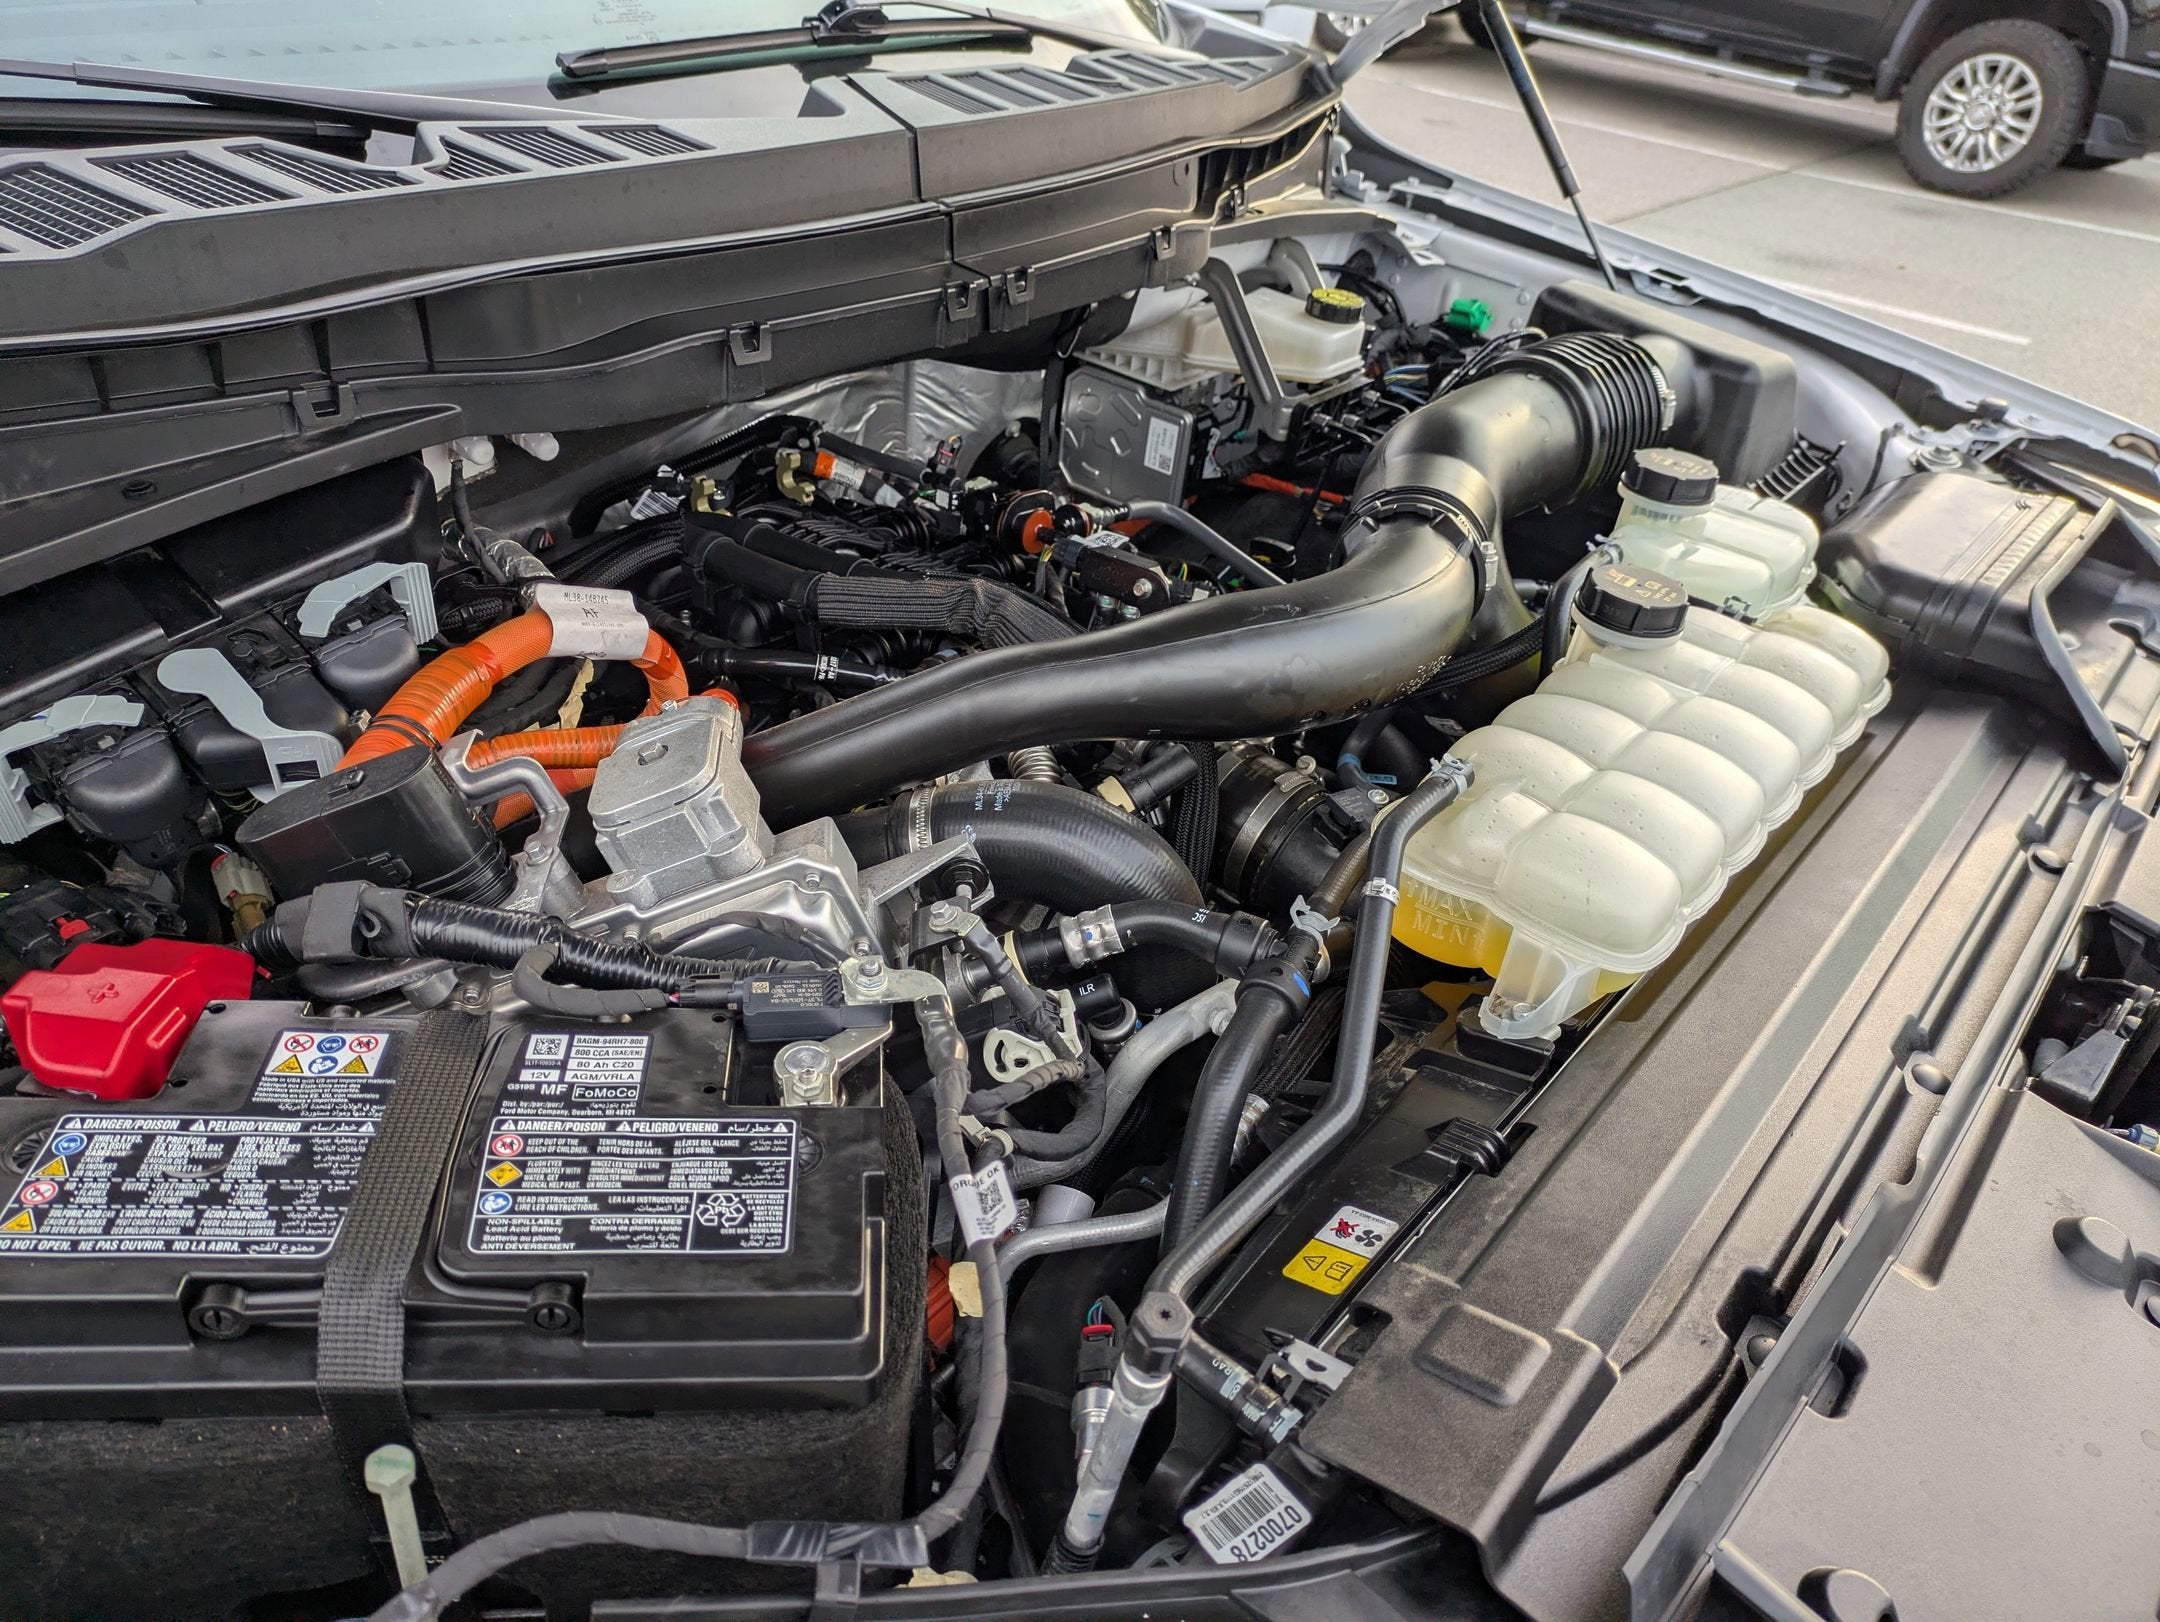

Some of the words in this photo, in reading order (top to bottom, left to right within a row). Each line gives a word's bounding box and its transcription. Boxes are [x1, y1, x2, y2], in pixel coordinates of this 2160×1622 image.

[564, 592, 608, 605] ML38-14B245
[1418, 885, 1473, 920] MAX
[1192, 912, 1206, 923] ISC
[1412, 910, 1470, 945] MIN
[1079, 983, 1095, 996] ILR
[576, 1037, 644, 1045] BAGM-94RH7-800
[575, 1049, 590, 1057] 800
[540, 1085, 568, 1095] MF
[575, 1087, 636, 1098] FoMoCo
[83, 1119, 180, 1130] DANGER/POISON
[207, 1121, 301, 1132] PELIGRO/VENENO
[517, 1122, 606, 1131] DANGER/POISON
[633, 1122, 718, 1133] PELIGRO/VENENO
[953, 1176, 985, 1191] ORQUE
[987, 1166, 999, 1178] OK
[219, 1183, 232, 1191] NO
[148, 1210, 194, 1218] SULFURIQUE
[12, 1240, 36, 1250] NOT
[38, 1240, 71, 1250] OPEN.
[78, 1241, 95, 1250] NE
[96, 1241, 119, 1250] PAS
[120, 1241, 166, 1250] OUVRIR.
[172, 1241, 189, 1250] NO
[191, 1242, 206, 1251] LA
[208, 1242, 241, 1252] ABRA.
[1230, 1505, 1302, 1562] 0700278
